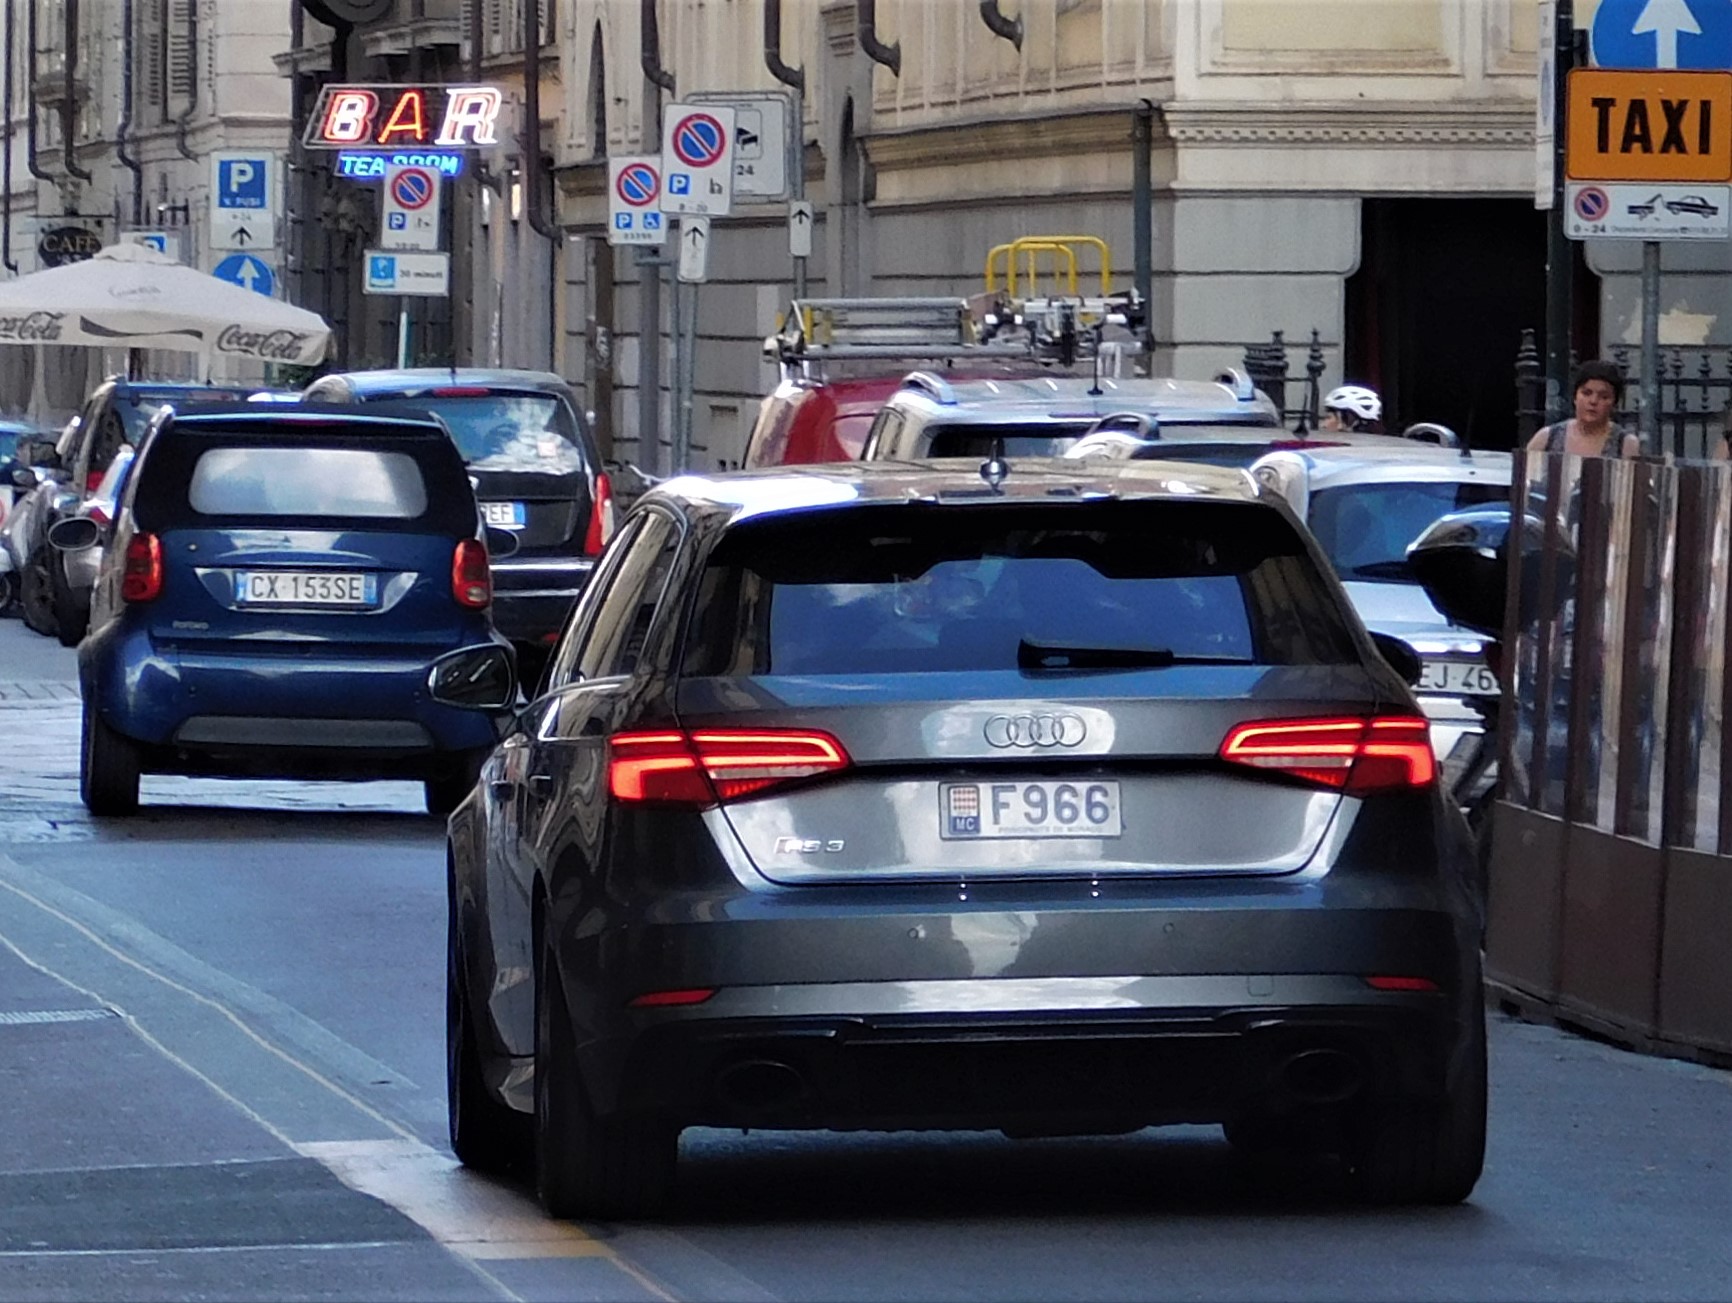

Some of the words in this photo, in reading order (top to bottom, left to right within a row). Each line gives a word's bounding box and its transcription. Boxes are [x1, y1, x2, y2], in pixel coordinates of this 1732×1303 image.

[320, 86, 502, 145] BAR
[1591, 97, 1712, 155] TAXI
[341, 156, 386, 176] TEA
[230, 163, 254, 193] P
[673, 176, 687, 192] P
[392, 214, 404, 229] P
[619, 214, 631, 227] P
[251, 576, 279, 598] CX
[292, 577, 361, 600] 153SE
[992, 784, 1109, 825] F966
[956, 818, 975, 830] MC
